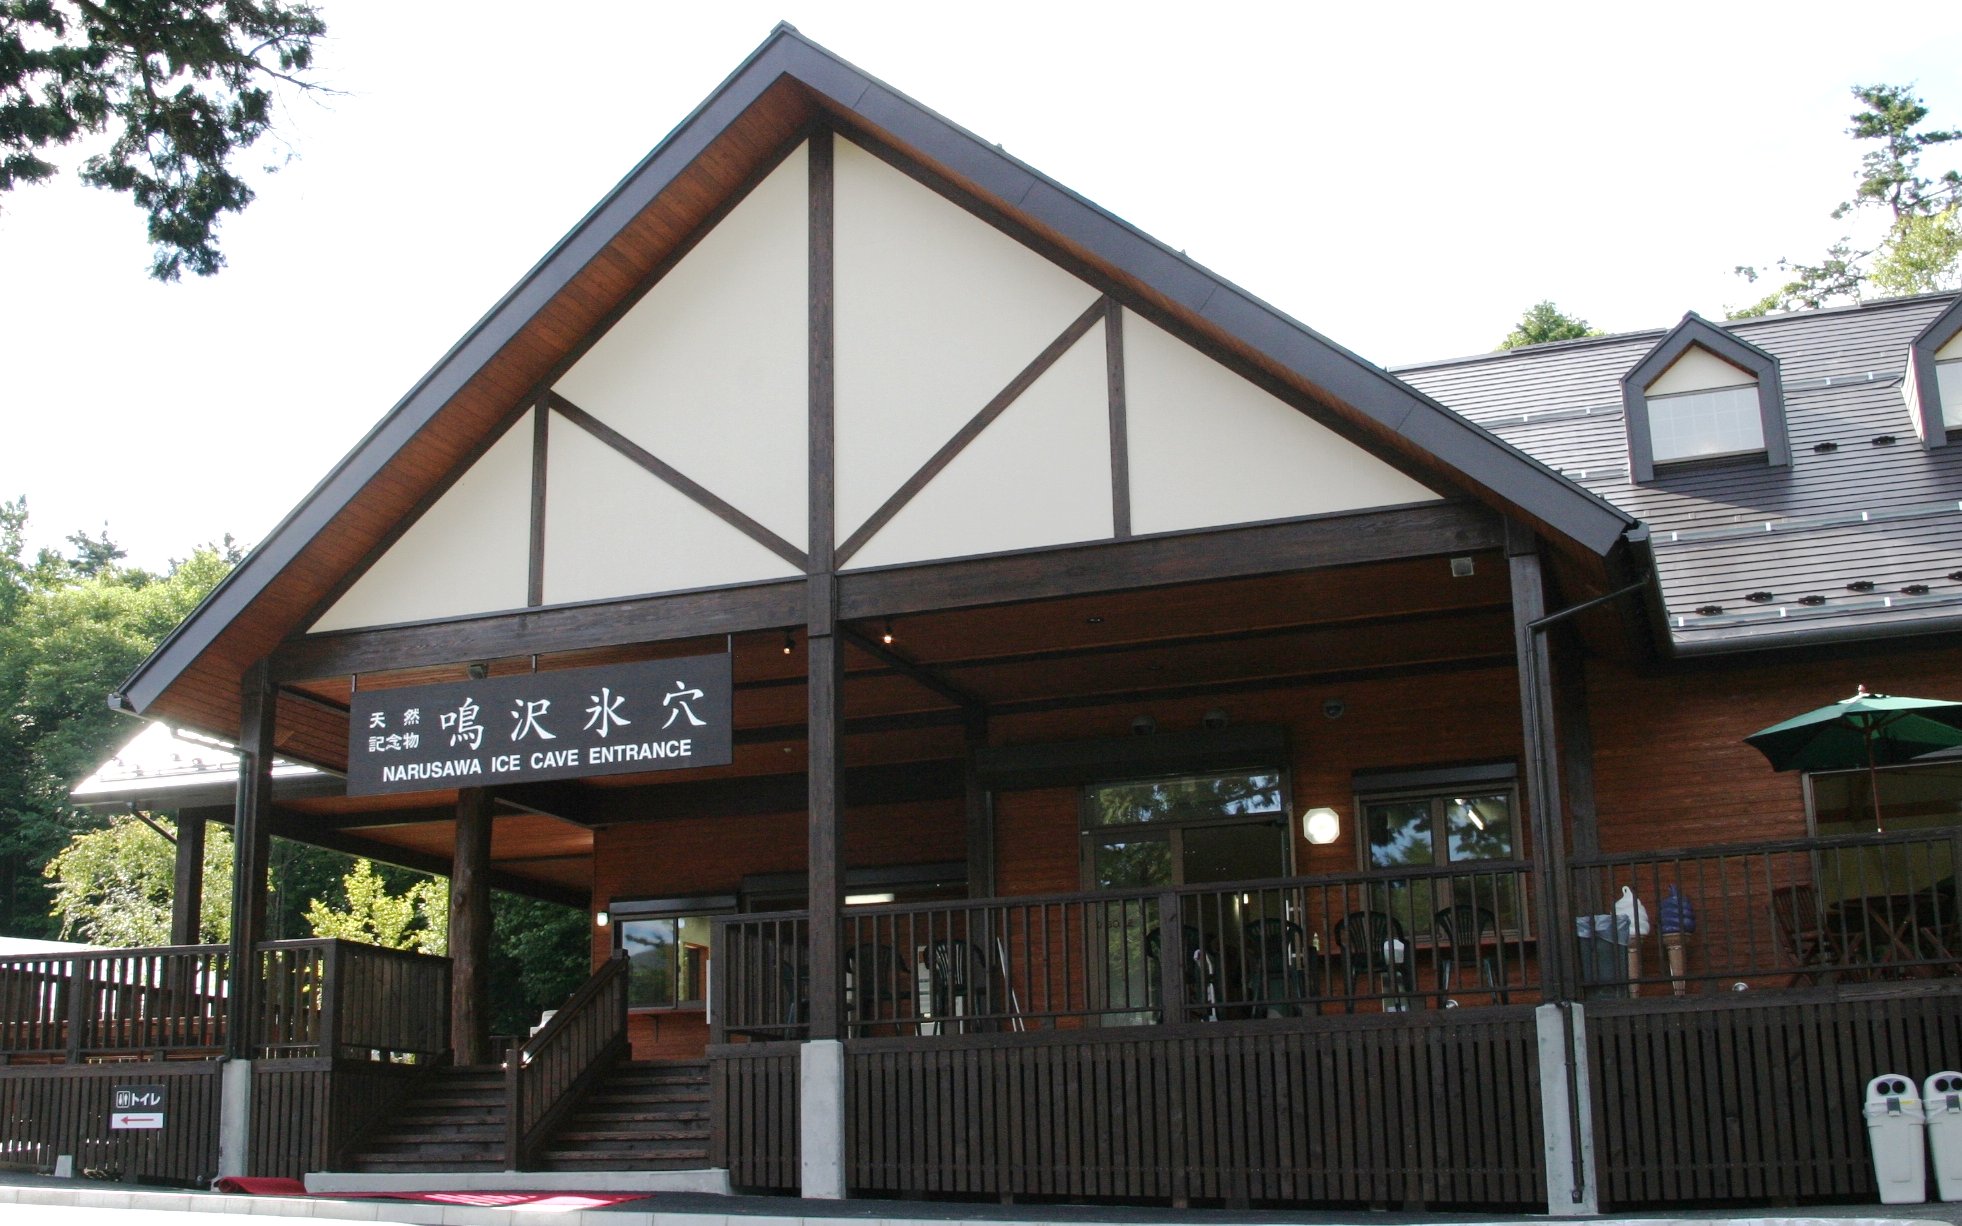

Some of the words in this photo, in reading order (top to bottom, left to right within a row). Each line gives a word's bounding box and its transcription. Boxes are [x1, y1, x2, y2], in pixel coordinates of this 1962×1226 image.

[368, 707, 420, 729] 天然
[439, 680, 707, 751] 鳴沢氷穴
[368, 731, 420, 753] 記念物
[382, 758, 482, 783] NARUSAWA
[491, 755, 521, 773] ICE
[531, 749, 580, 770] CAVE
[589, 739, 692, 765] ENTRANCE
[131, 1092, 161, 1106] トイレ
